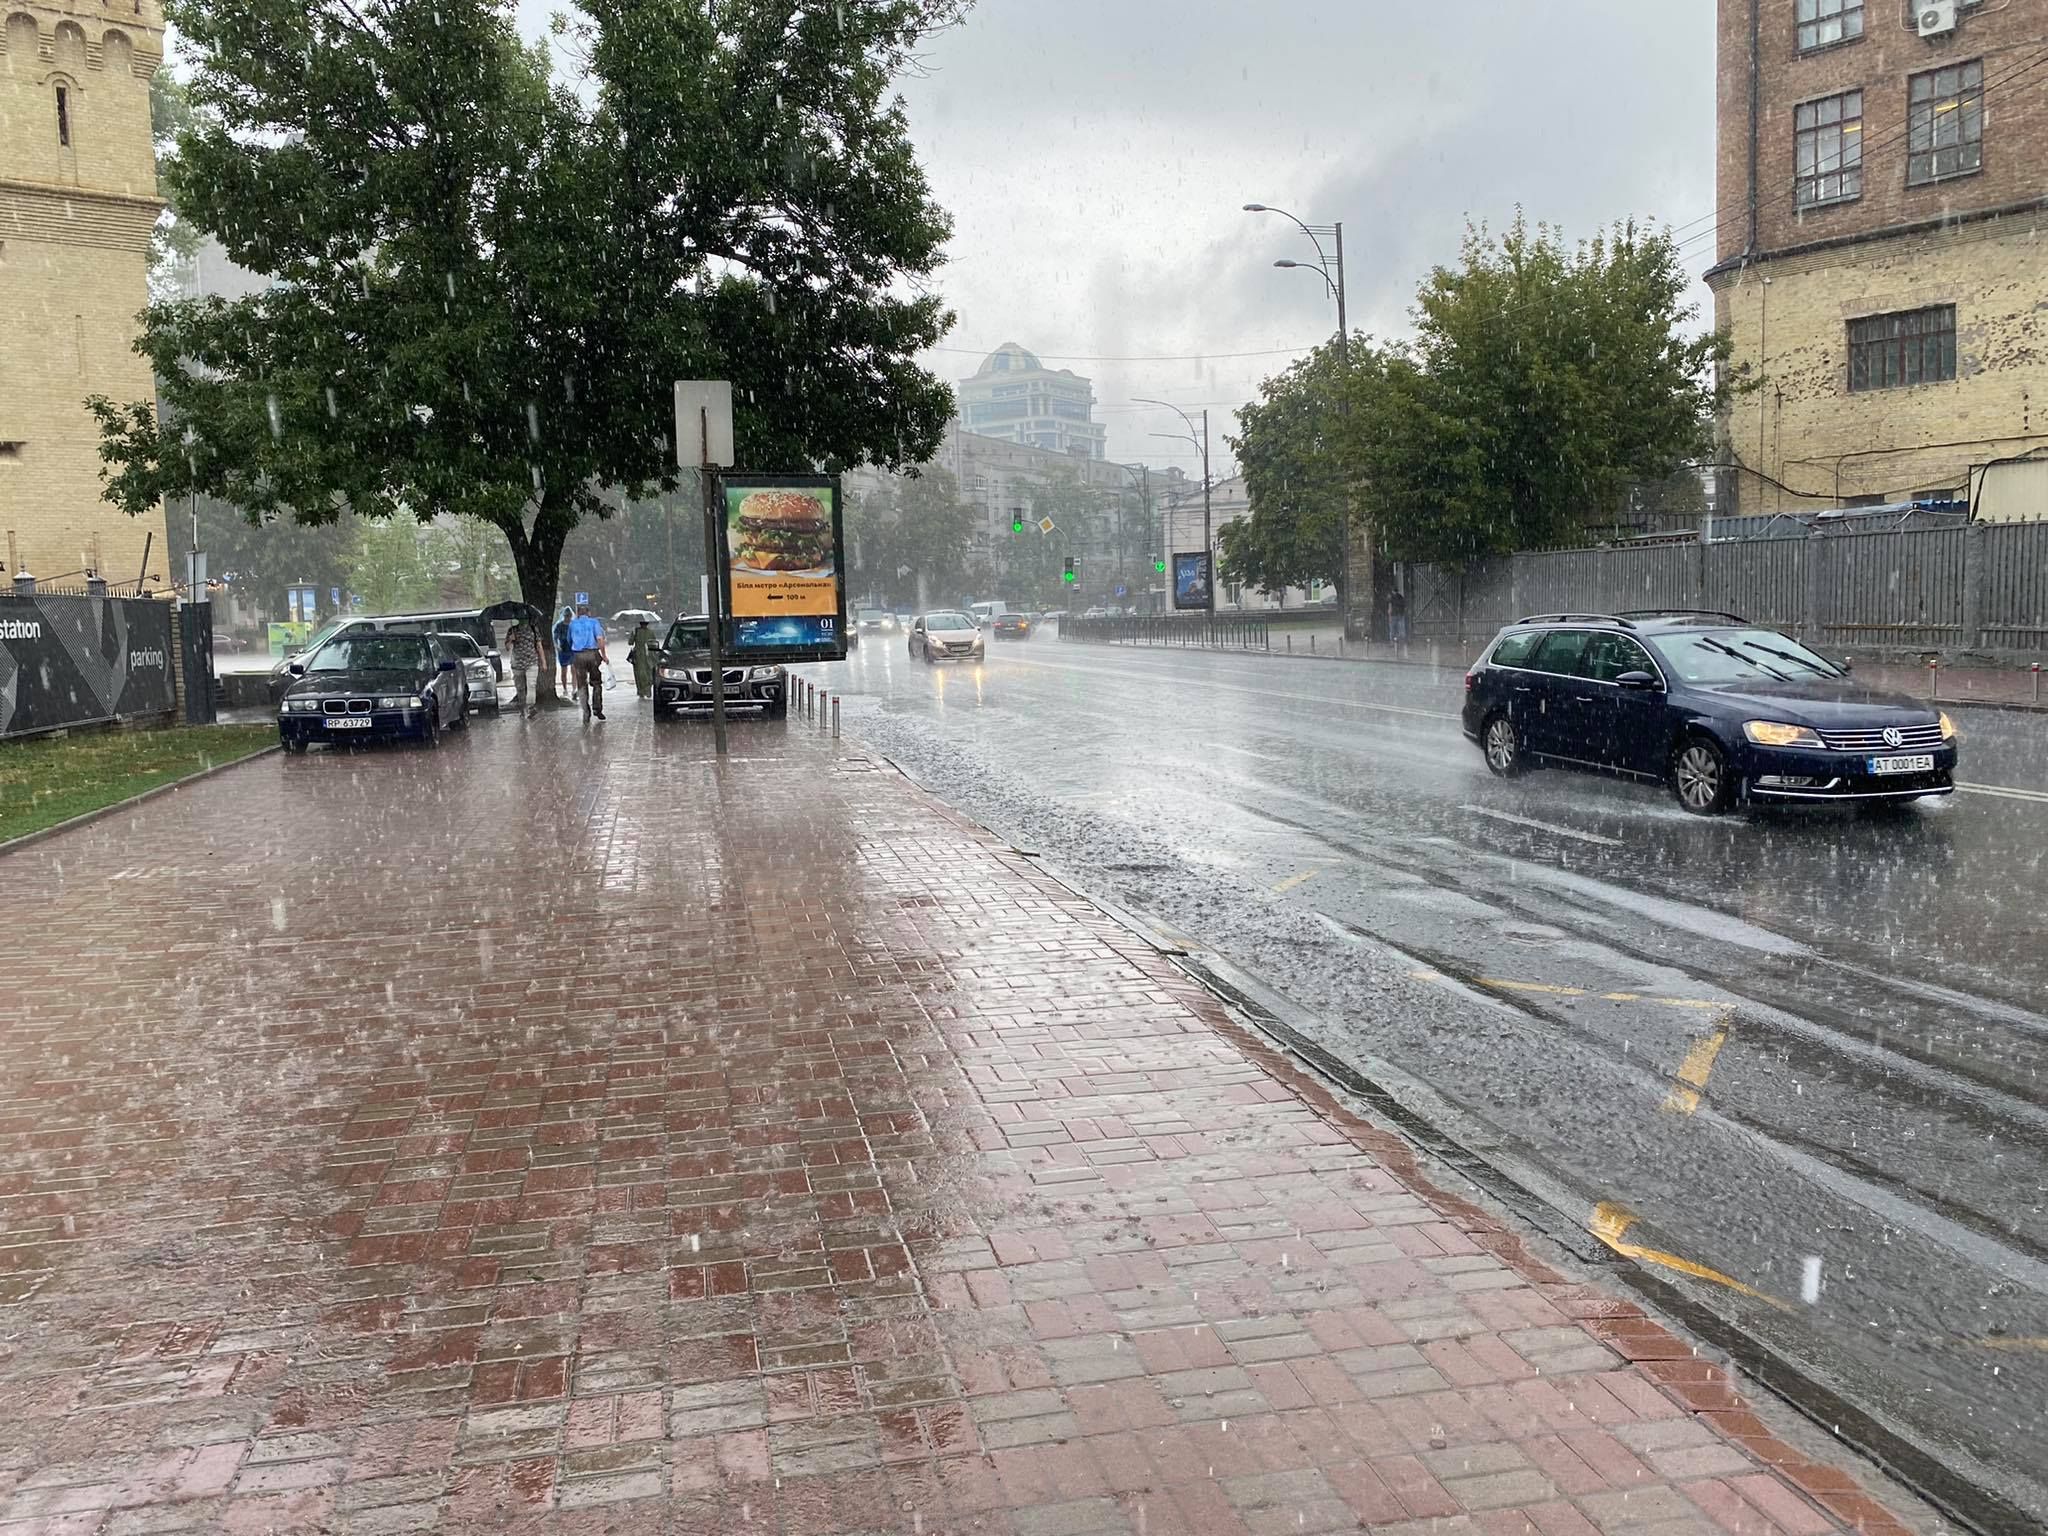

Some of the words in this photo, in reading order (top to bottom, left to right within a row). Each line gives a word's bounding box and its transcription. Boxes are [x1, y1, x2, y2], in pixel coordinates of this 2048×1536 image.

[820, 618, 833, 629] 01
[130, 646, 164, 672] parking
[328, 719, 340, 728] RP
[343, 718, 370, 728] 63729
[1876, 759, 1890, 771] AT
[1892, 758, 1914, 770] 0001
[1916, 757, 1932, 769] EA
